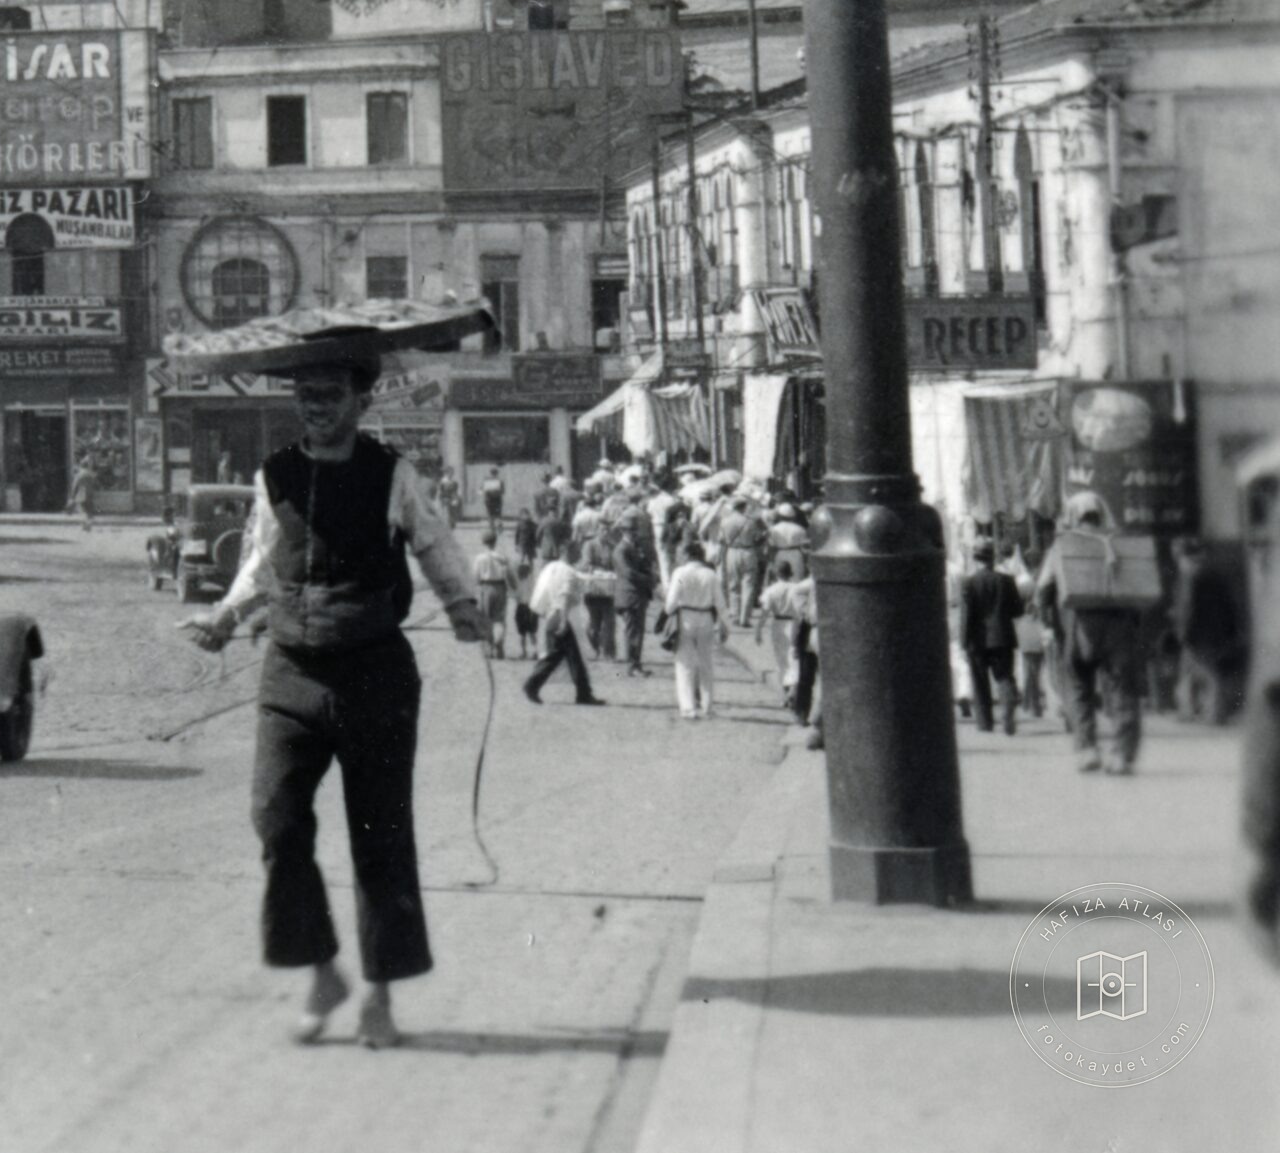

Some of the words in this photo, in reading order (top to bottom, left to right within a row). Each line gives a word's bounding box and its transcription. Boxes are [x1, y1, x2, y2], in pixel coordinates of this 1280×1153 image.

[444, 31, 672, 92] GISLAVED
[127, 106, 144, 123] VE
[31, 189, 129, 221] PAZARI
[921, 316, 1028, 366] RECEP
